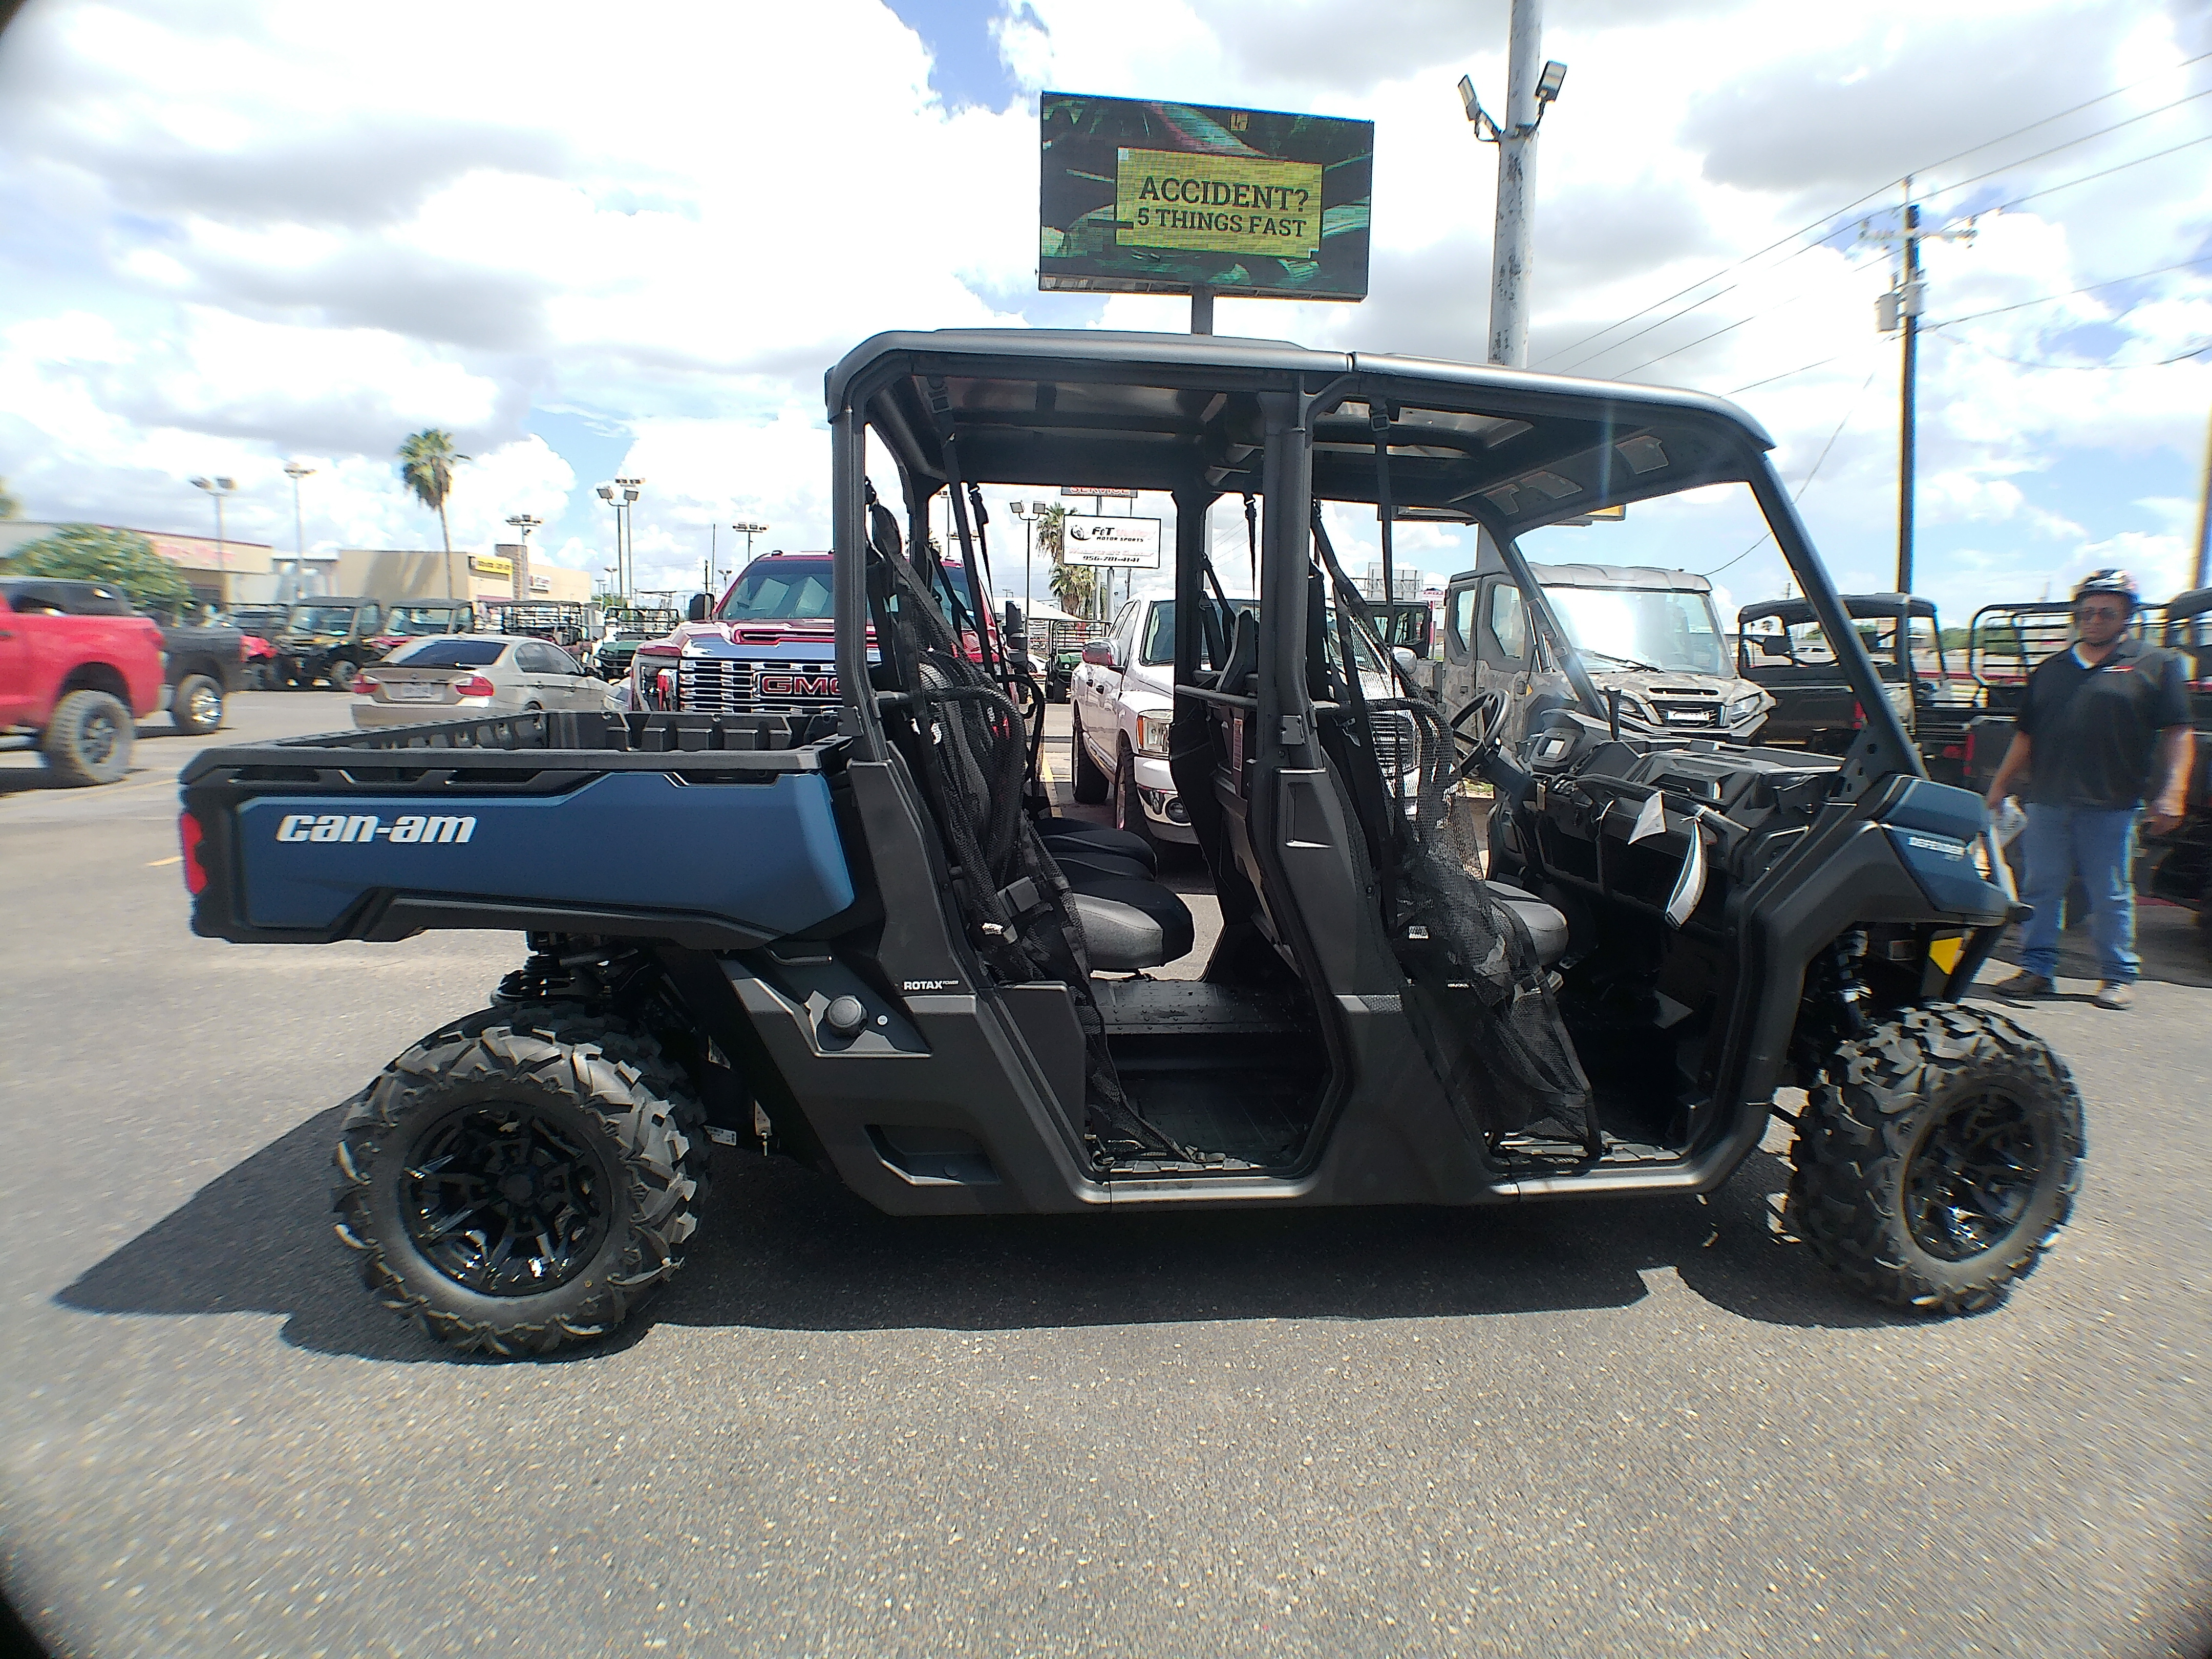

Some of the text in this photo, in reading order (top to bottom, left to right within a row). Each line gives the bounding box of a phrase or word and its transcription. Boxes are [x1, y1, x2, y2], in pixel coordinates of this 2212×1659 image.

[1138, 176, 1309, 212] ACCIDENT?
[1138, 207, 1307, 237] 5 THINGS FAST
[275, 815, 478, 842] can-am
[904, 981, 943, 990] ROTAX
